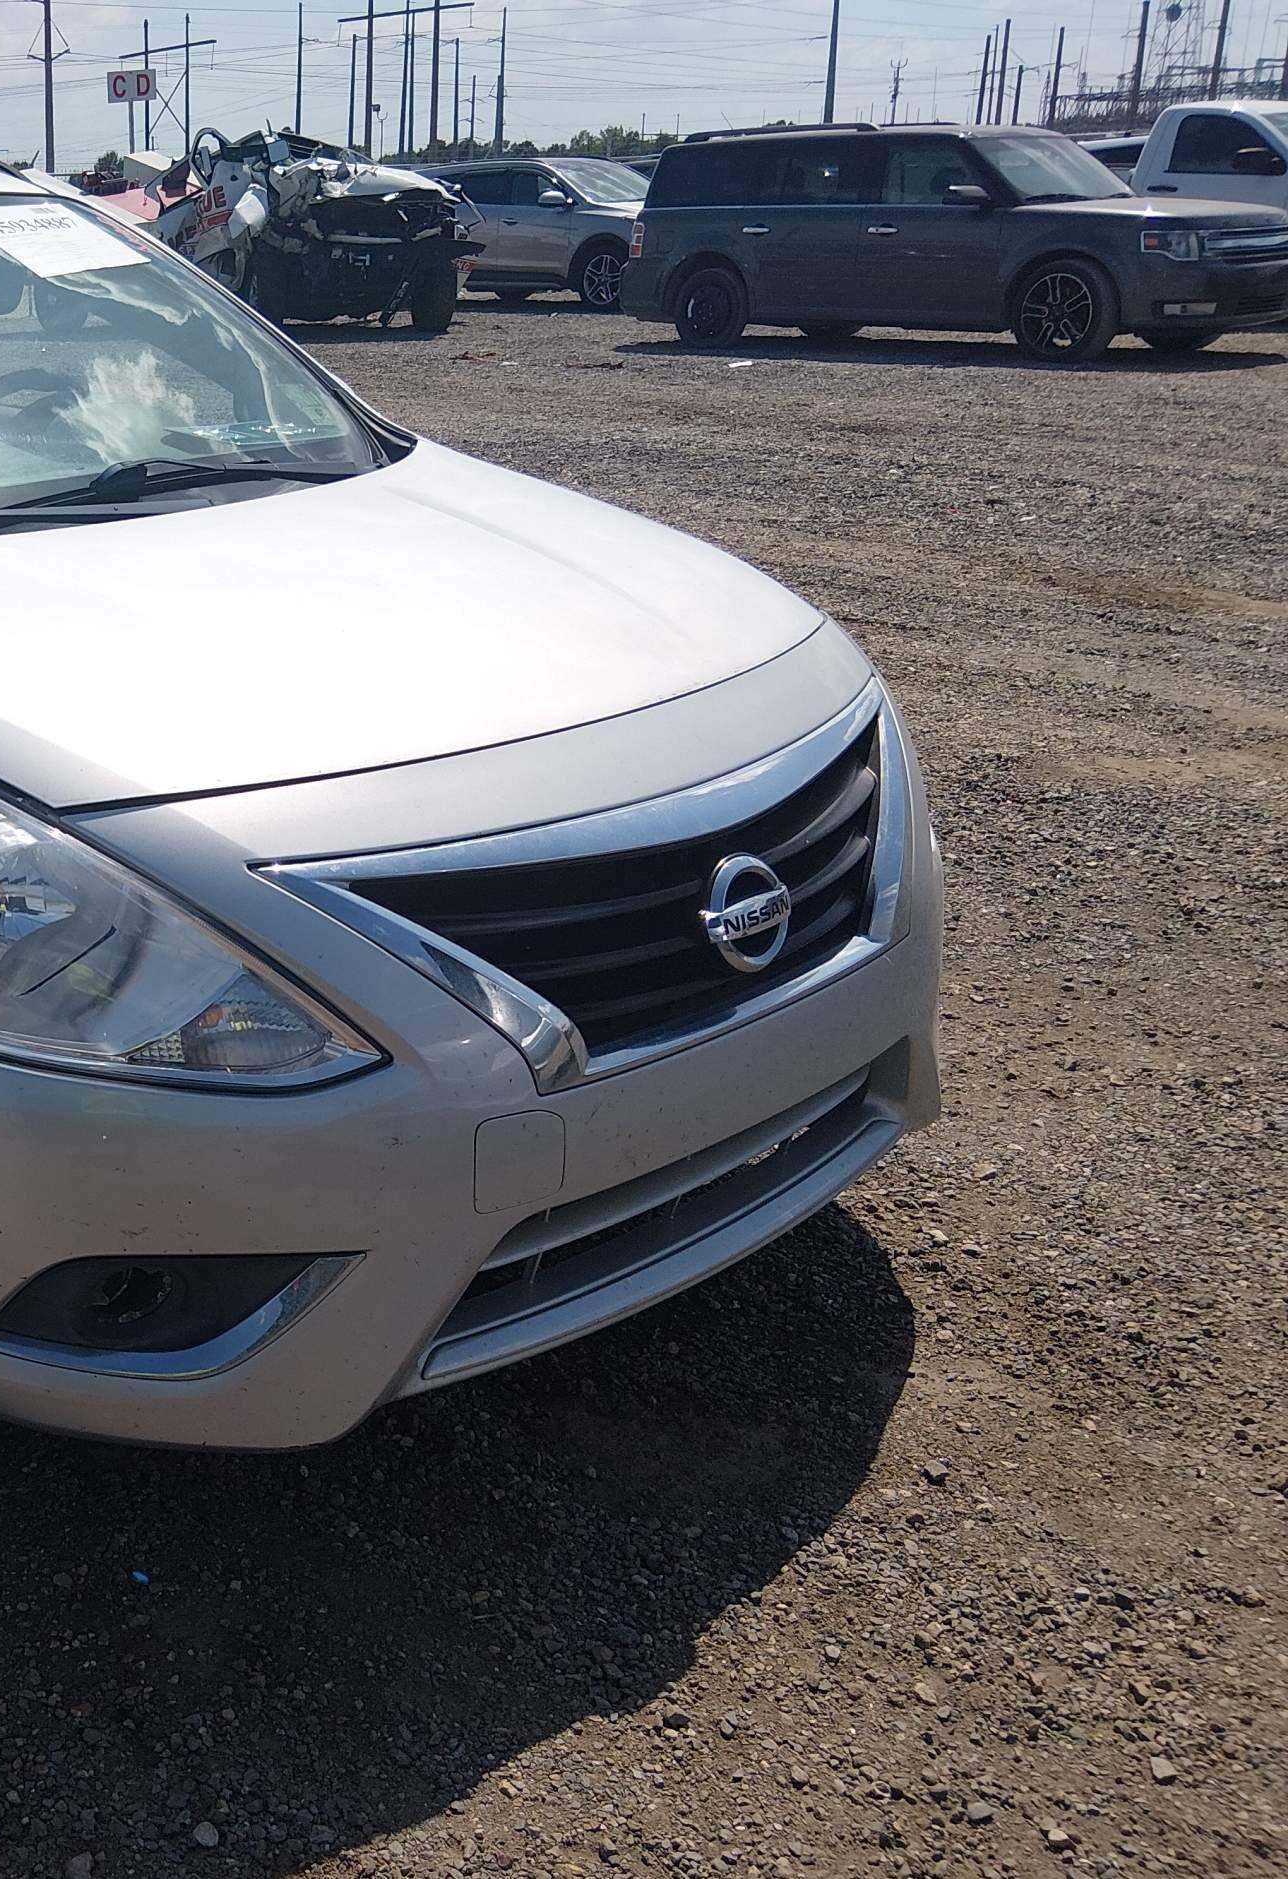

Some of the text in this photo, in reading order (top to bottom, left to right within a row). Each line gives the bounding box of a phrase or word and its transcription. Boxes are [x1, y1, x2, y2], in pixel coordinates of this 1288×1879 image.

[112, 73, 151, 98] C D
[723, 895, 789, 935] NISSAN
